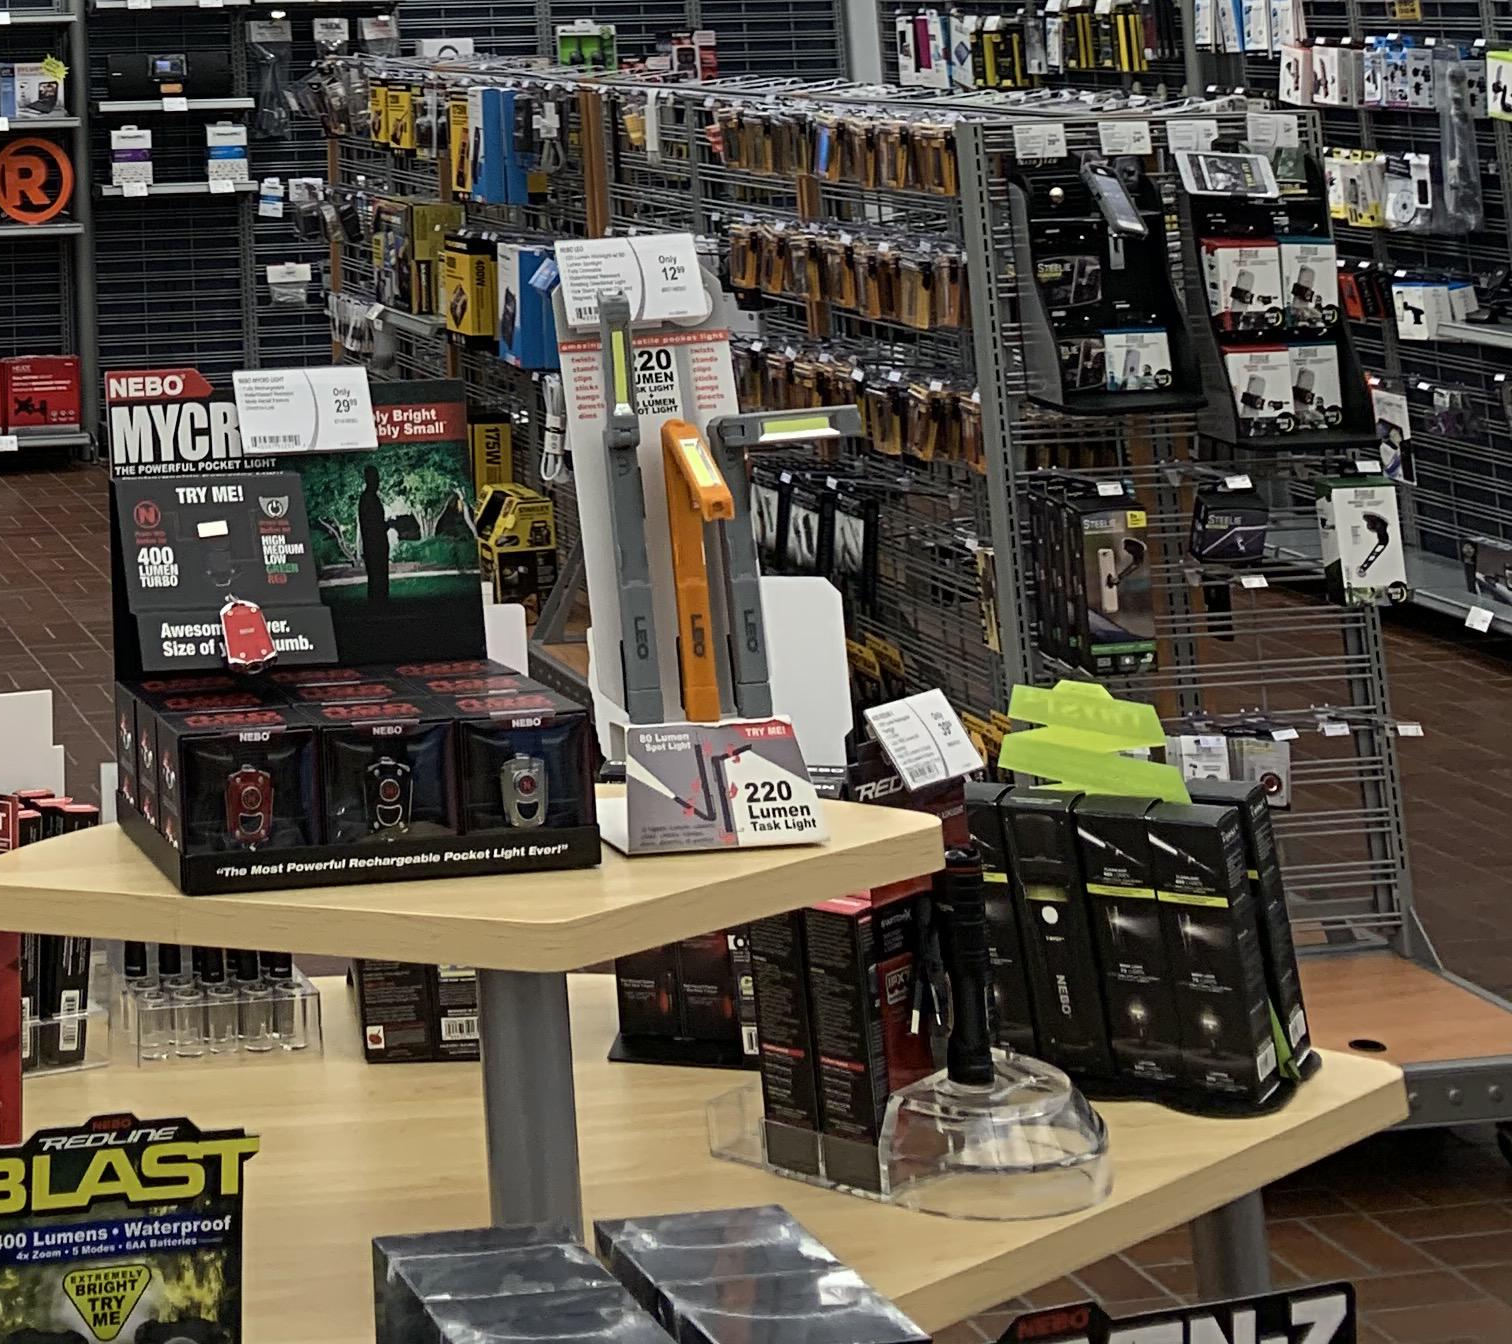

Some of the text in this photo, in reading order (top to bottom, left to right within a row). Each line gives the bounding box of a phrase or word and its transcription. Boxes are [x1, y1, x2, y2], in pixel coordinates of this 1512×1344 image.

[658, 255, 678, 265] Only
[662, 331, 725, 345] pocket light
[634, 348, 672, 371] 20
[107, 373, 186, 399] NEBO
[332, 388, 351, 397] Only
[648, 384, 675, 393] LIGHT
[642, 398, 676, 407] LUMEN
[651, 405, 678, 414] LIGHT
[393, 408, 437, 425] Bright
[110, 402, 244, 465] MYCR
[403, 421, 445, 437] Small
[485, 426, 502, 465] 175W
[114, 458, 277, 477] THE POWERFUL POCKET LIGHT
[175, 484, 245, 505] TRY ME!
[261, 535, 286, 547] HIGH
[262, 543, 305, 556] MEDIUM
[137, 546, 174, 565] 400
[264, 553, 287, 565] LOW
[138, 563, 179, 576] LUMEN
[139, 575, 179, 588] TURBO
[267, 573, 288, 585] RED
[160, 619, 225, 639] Awesom
[633, 615, 649, 661] LEO
[690, 612, 706, 659] LEO
[743, 608, 759, 654] LEO
[162, 635, 315, 658] Size of umb.
[372, 725, 403, 737] NEBO
[511, 717, 542, 729] NEBO
[239, 730, 270, 743] NEBO
[639, 725, 787, 744] 80 Lumen TRY ME!
[645, 741, 692, 752] Spot Light
[744, 780, 793, 804] 220
[748, 802, 812, 821] Lumen
[750, 817, 817, 832] Task Light
[250, 863, 284, 876] Most
[287, 858, 346, 873] Powerful
[349, 851, 441, 869] Rechargeable
[444, 848, 491, 863] Pocket
[493, 846, 526, 861] Light
[1055, 973, 1072, 1019] NEBO
[38, 1126, 180, 1152] REDLINE
[32, 1224, 109, 1248] Lumens
[124, 1213, 233, 1241] Waterproof
[15, 1251, 30, 1261] 4x
[31, 1247, 62, 1261] Zoom
[81, 1242, 116, 1256] Modes
[149, 1235, 198, 1249] Batteries
[69, 1268, 145, 1286] EXTREMELY
[74, 1278, 139, 1298] BRIGHT
[88, 1295, 127, 1310] TRY
[91, 1311, 122, 1329] ME
